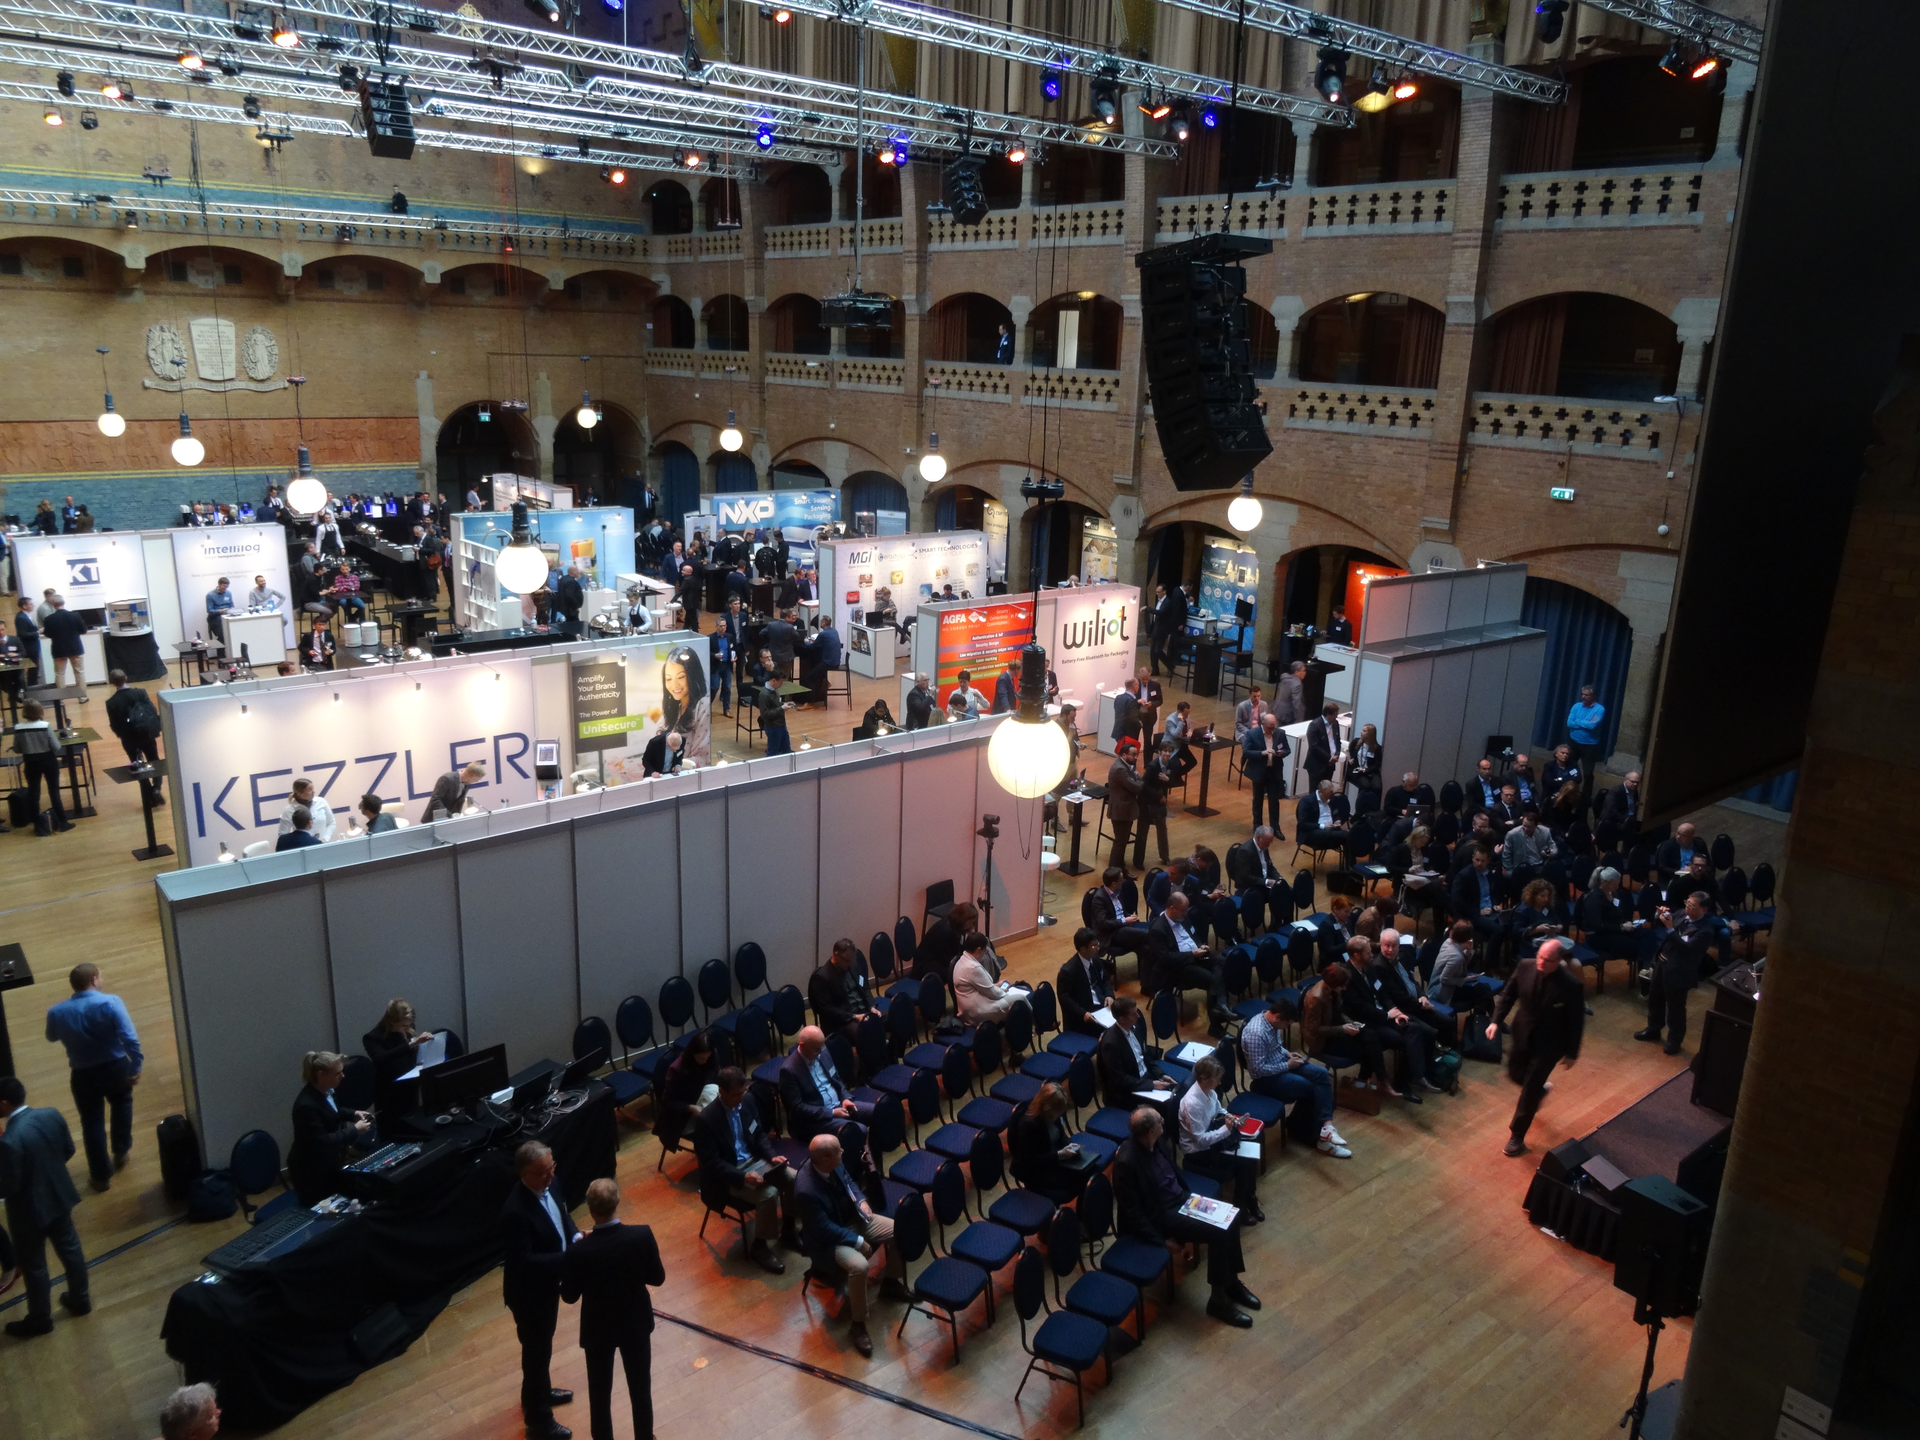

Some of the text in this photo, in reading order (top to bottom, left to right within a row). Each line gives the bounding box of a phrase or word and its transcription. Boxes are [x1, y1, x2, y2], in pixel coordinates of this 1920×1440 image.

[719, 500, 775, 525] NXP
[803, 512, 833, 520] Packaging.
[201, 544, 260, 555] intellilog
[937, 543, 978, 552] TECHNOLOGIES
[942, 613, 967, 625] AGFA
[1062, 605, 1130, 650] wiliot
[1061, 657, 1085, 665] Battery-Free
[577, 674, 605, 684] Amplify
[577, 682, 617, 693] Your Brand
[578, 690, 621, 702] Authenticity
[591, 709, 611, 717] Power
[192, 732, 532, 838] KEZZLER
